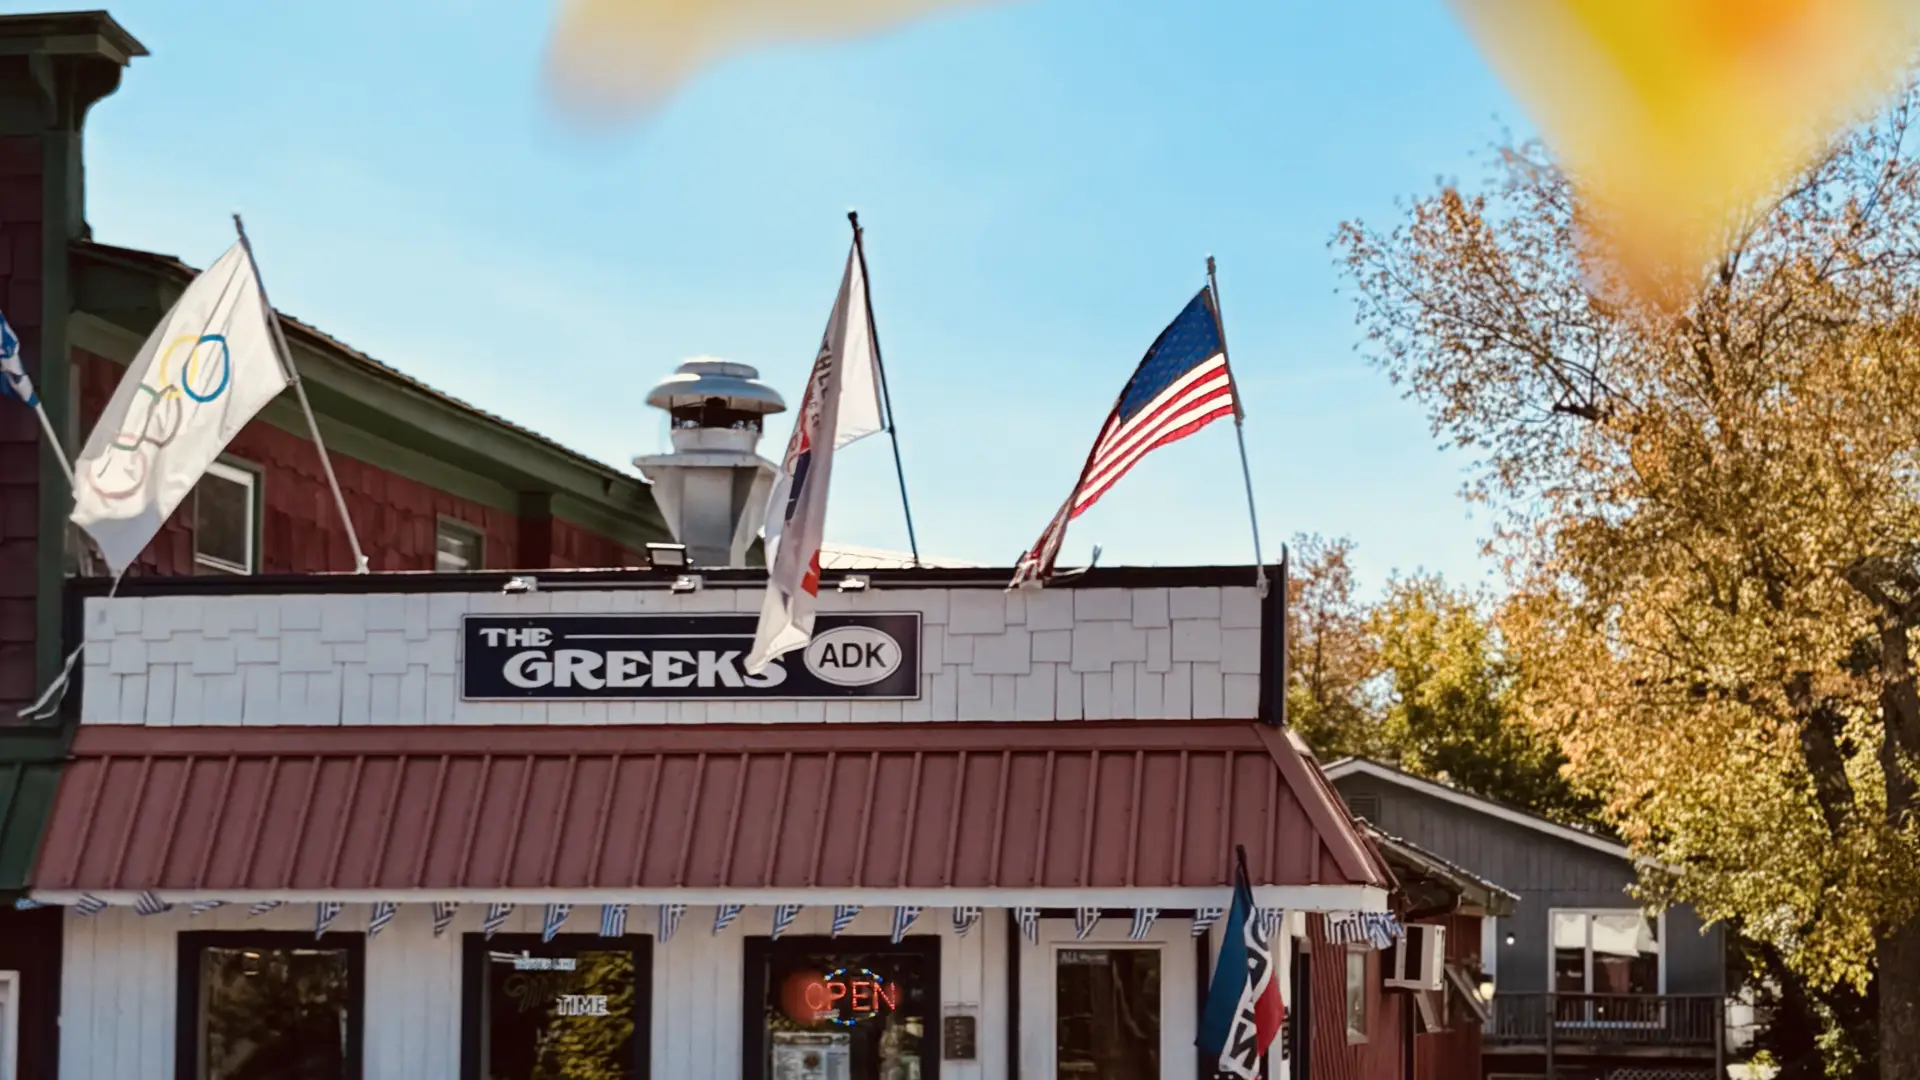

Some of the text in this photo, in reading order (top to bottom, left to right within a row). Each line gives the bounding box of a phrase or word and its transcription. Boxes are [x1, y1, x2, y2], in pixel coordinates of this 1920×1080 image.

[479, 627, 553, 648] THE
[818, 641, 888, 669] ADK
[502, 649, 788, 690] GREEKS
[556, 994, 611, 1016] TIME
[805, 981, 896, 1012] OPEN
